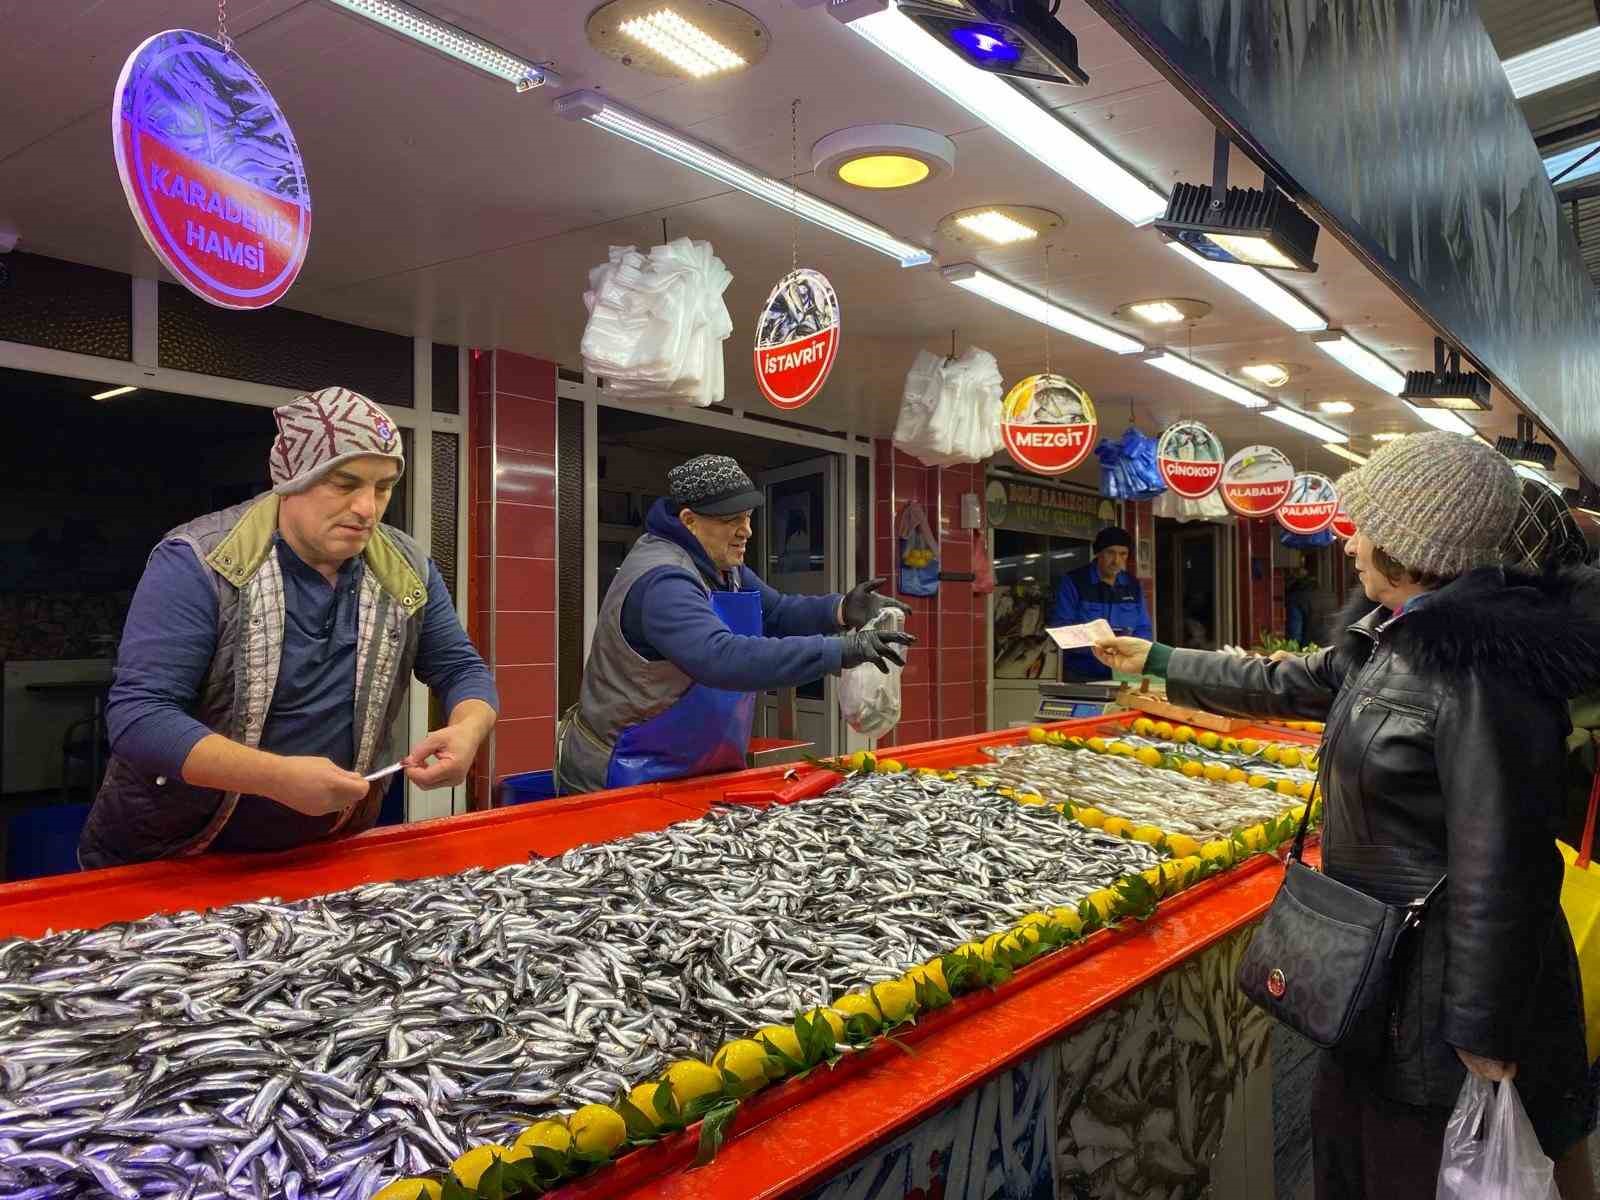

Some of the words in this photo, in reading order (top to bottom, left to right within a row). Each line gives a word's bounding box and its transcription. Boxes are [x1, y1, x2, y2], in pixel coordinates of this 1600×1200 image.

[151, 161, 293, 247] KARADENİZ
[187, 220, 265, 273] HAMSİ
[764, 340, 826, 374] İSTAVRİT
[1015, 427, 1084, 447] MEZGİT
[1167, 462, 1217, 478] ÇİNOKOP
[1229, 485, 1285, 497] ALABALIK
[1281, 505, 1333, 516] PALAMUT
